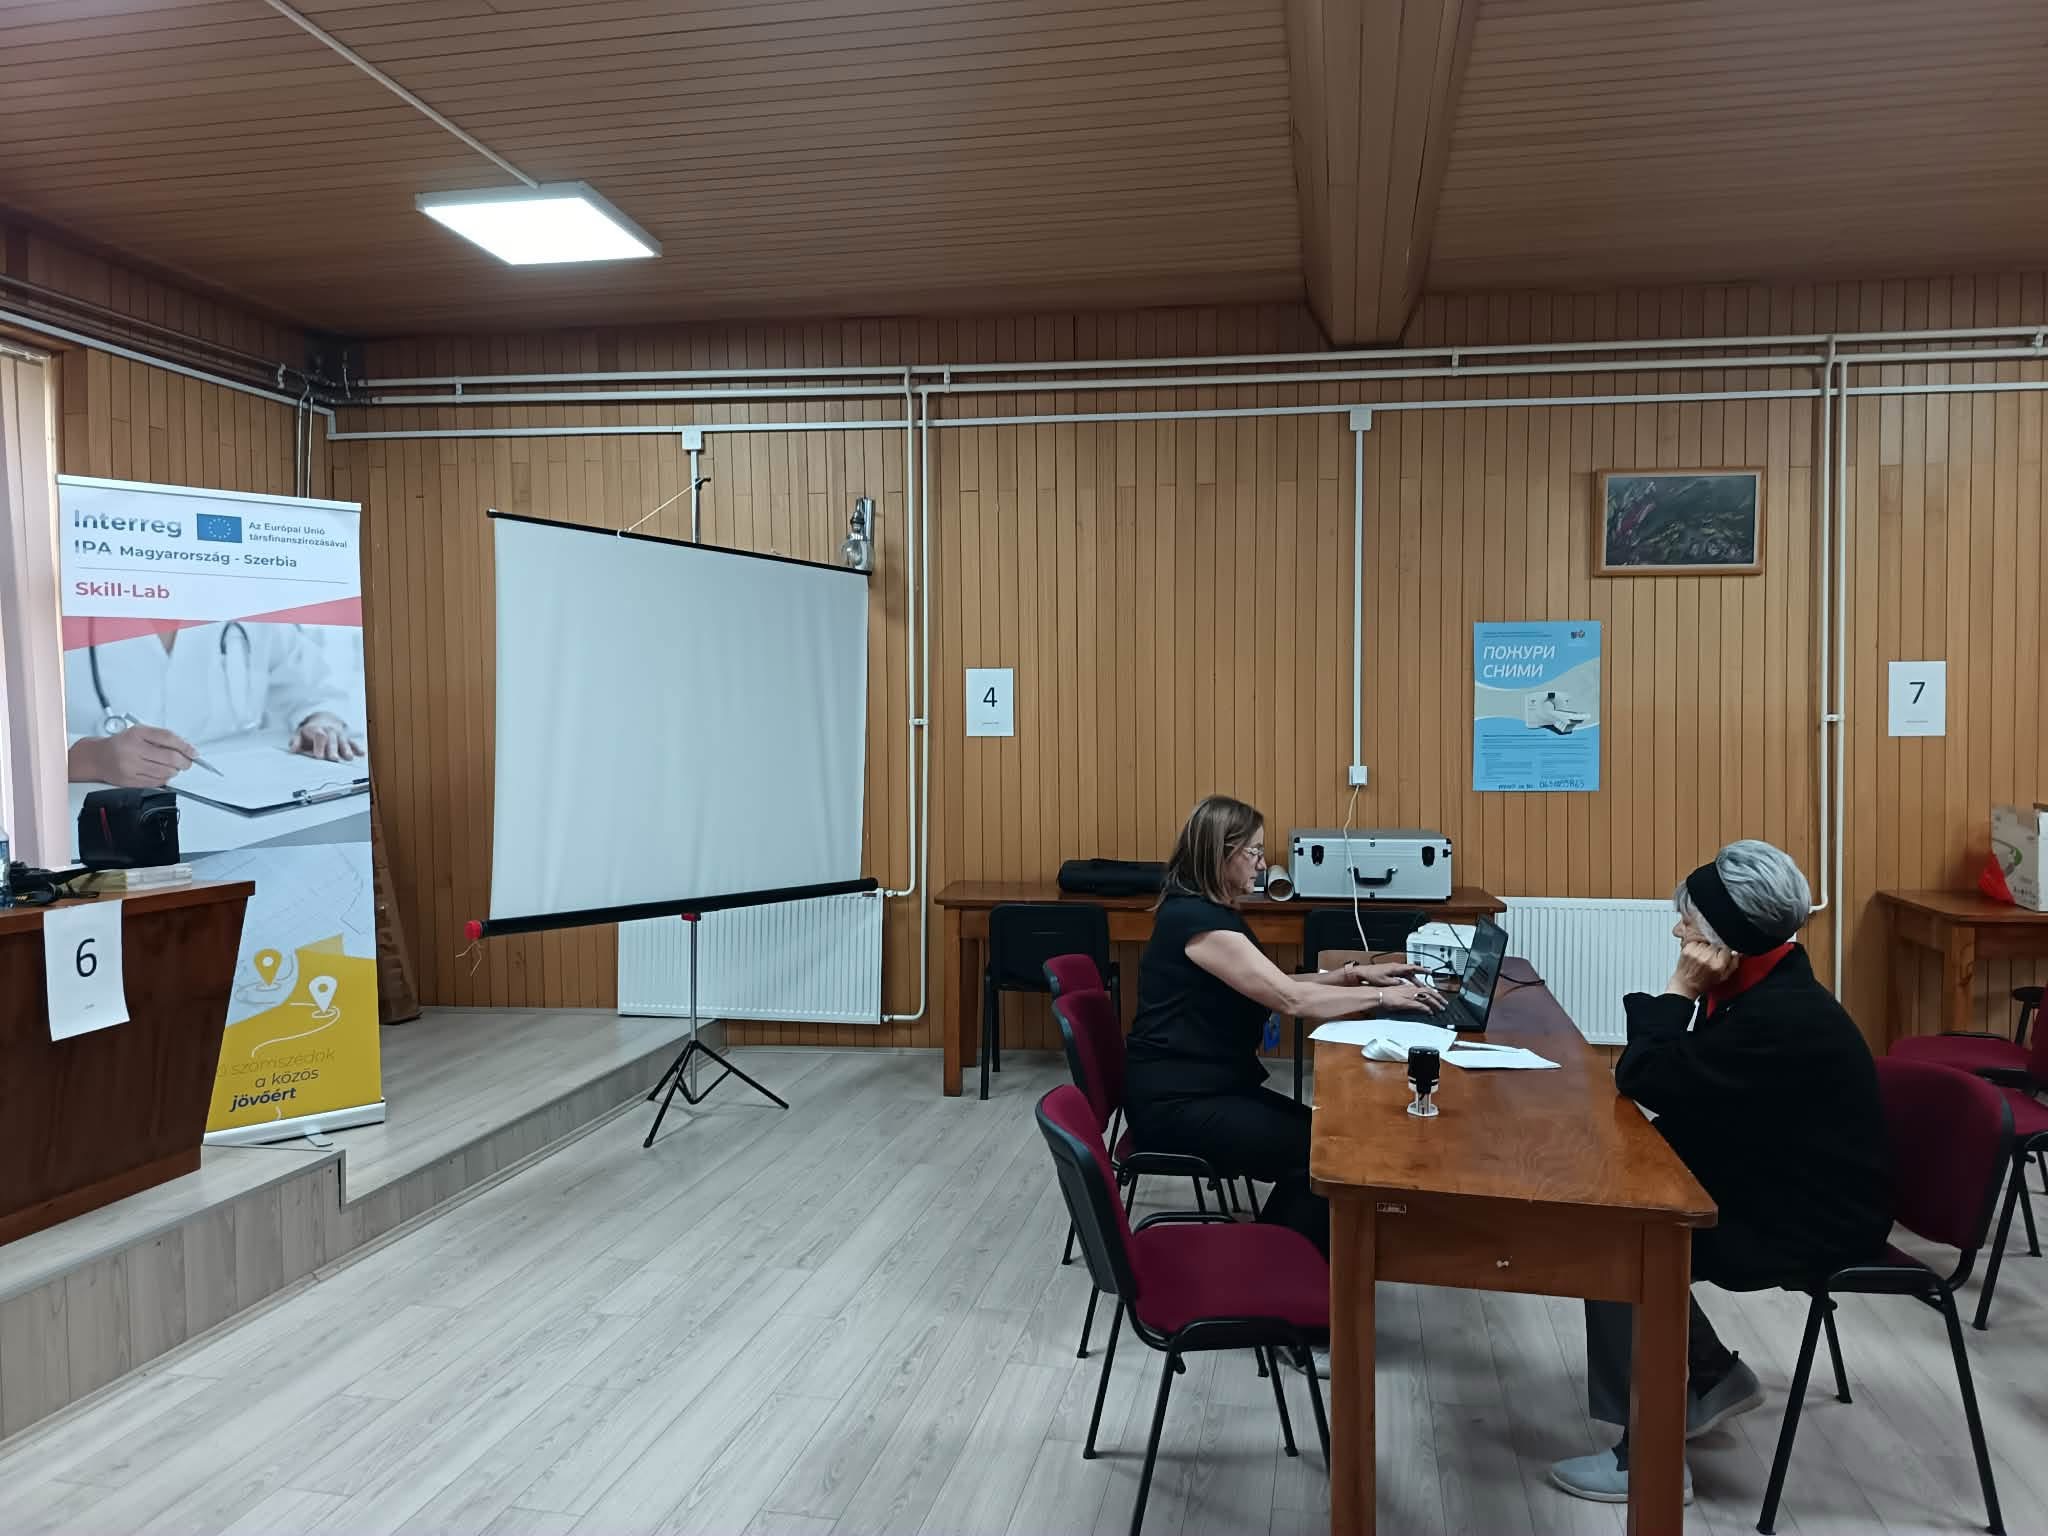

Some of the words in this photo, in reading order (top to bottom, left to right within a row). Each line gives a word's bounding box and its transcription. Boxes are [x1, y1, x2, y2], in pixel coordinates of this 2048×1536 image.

[74, 509, 182, 538] Interreg
[249, 521, 261, 530] Az
[264, 522, 301, 534] Európai
[303, 525, 325, 535] Unió
[74, 539, 112, 555] IPA
[120, 545, 230, 566] Magyarország
[243, 554, 297, 568] Szerbia
[75, 581, 170, 599] Skill-Lab
[1483, 645, 1555, 660] ПОЖУРИ
[1483, 663, 1543, 678] СНИМИ
[983, 686, 998, 708] 4
[1909, 681, 1926, 705] 7
[76, 938, 97, 977] 6
[255, 1078, 266, 1088] a
[271, 1069, 319, 1086] közös
[229, 1087, 297, 1113] jövőért
